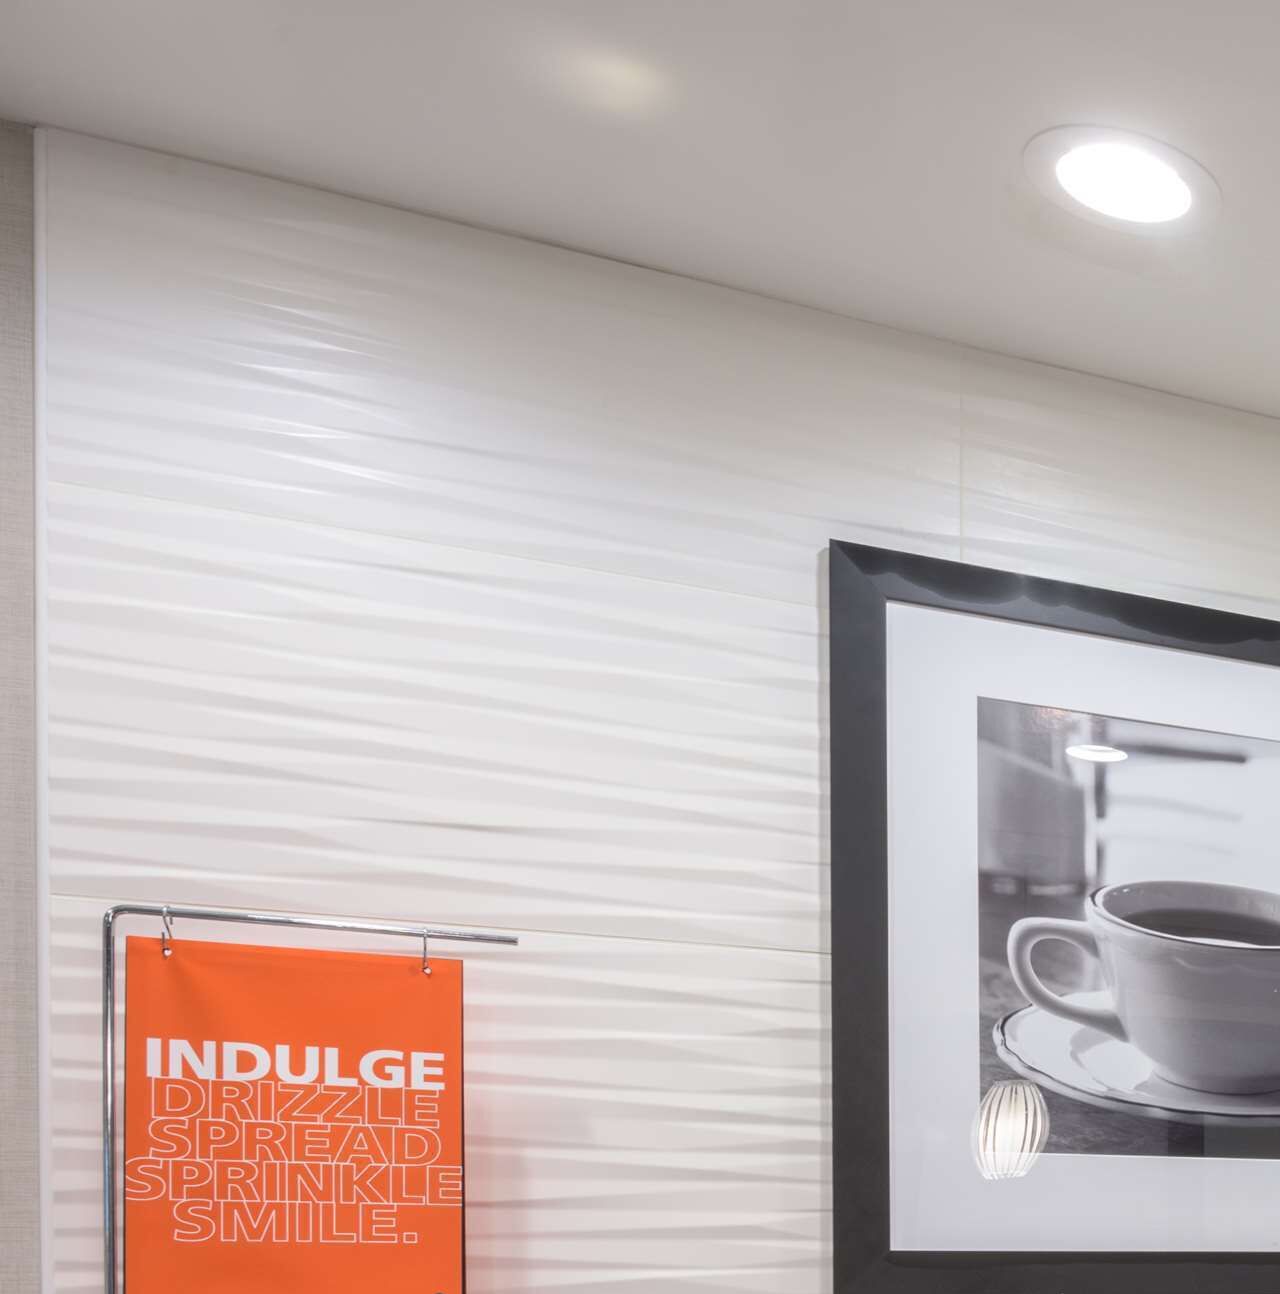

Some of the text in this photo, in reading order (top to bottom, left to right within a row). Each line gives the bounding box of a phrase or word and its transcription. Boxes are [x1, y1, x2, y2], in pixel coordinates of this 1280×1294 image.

[146, 1037, 446, 1091] INDULGE
[151, 1076, 441, 1129] DRIZZLE
[148, 1117, 443, 1166] SPREAD
[125, 1157, 463, 1206] SPRINKLE
[172, 1199, 418, 1244] SMILE.
